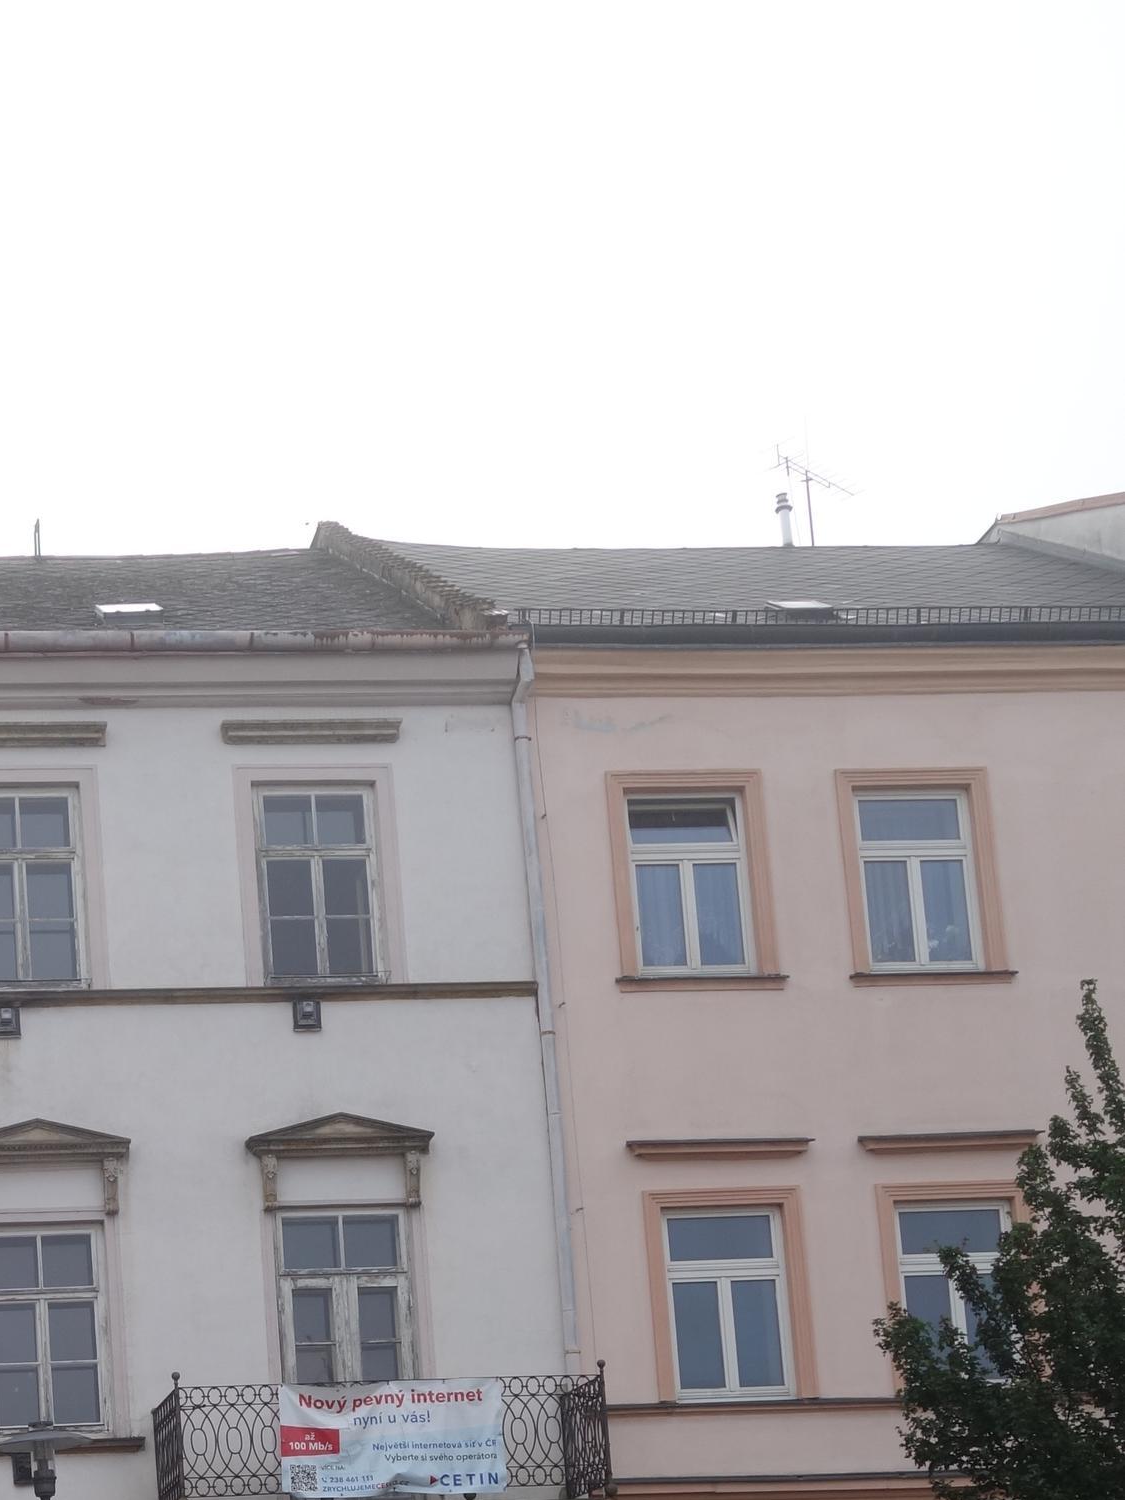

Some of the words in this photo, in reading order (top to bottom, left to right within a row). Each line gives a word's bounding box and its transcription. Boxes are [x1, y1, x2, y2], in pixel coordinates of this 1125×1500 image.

[298, 1393, 347, 1414] Nový
[351, 1390, 405, 1412] pevný
[410, 1388, 483, 1404] internet
[353, 1411, 383, 1430] nyní
[388, 1414, 396, 1424] u
[401, 1410, 431, 1424] vás!
[304, 1432, 316, 1441] až
[288, 1442, 307, 1451] 100
[308, 1441, 334, 1451] Mb/s
[372, 1440, 410, 1452] Největší
[411, 1439, 463, 1450] internetová
[384, 1453, 419, 1463] Vyberte
[420, 1453, 428, 1461] si
[429, 1453, 454, 1461] svého
[455, 1452, 498, 1462] operátora
[439, 1472, 499, 1487] CETIN
